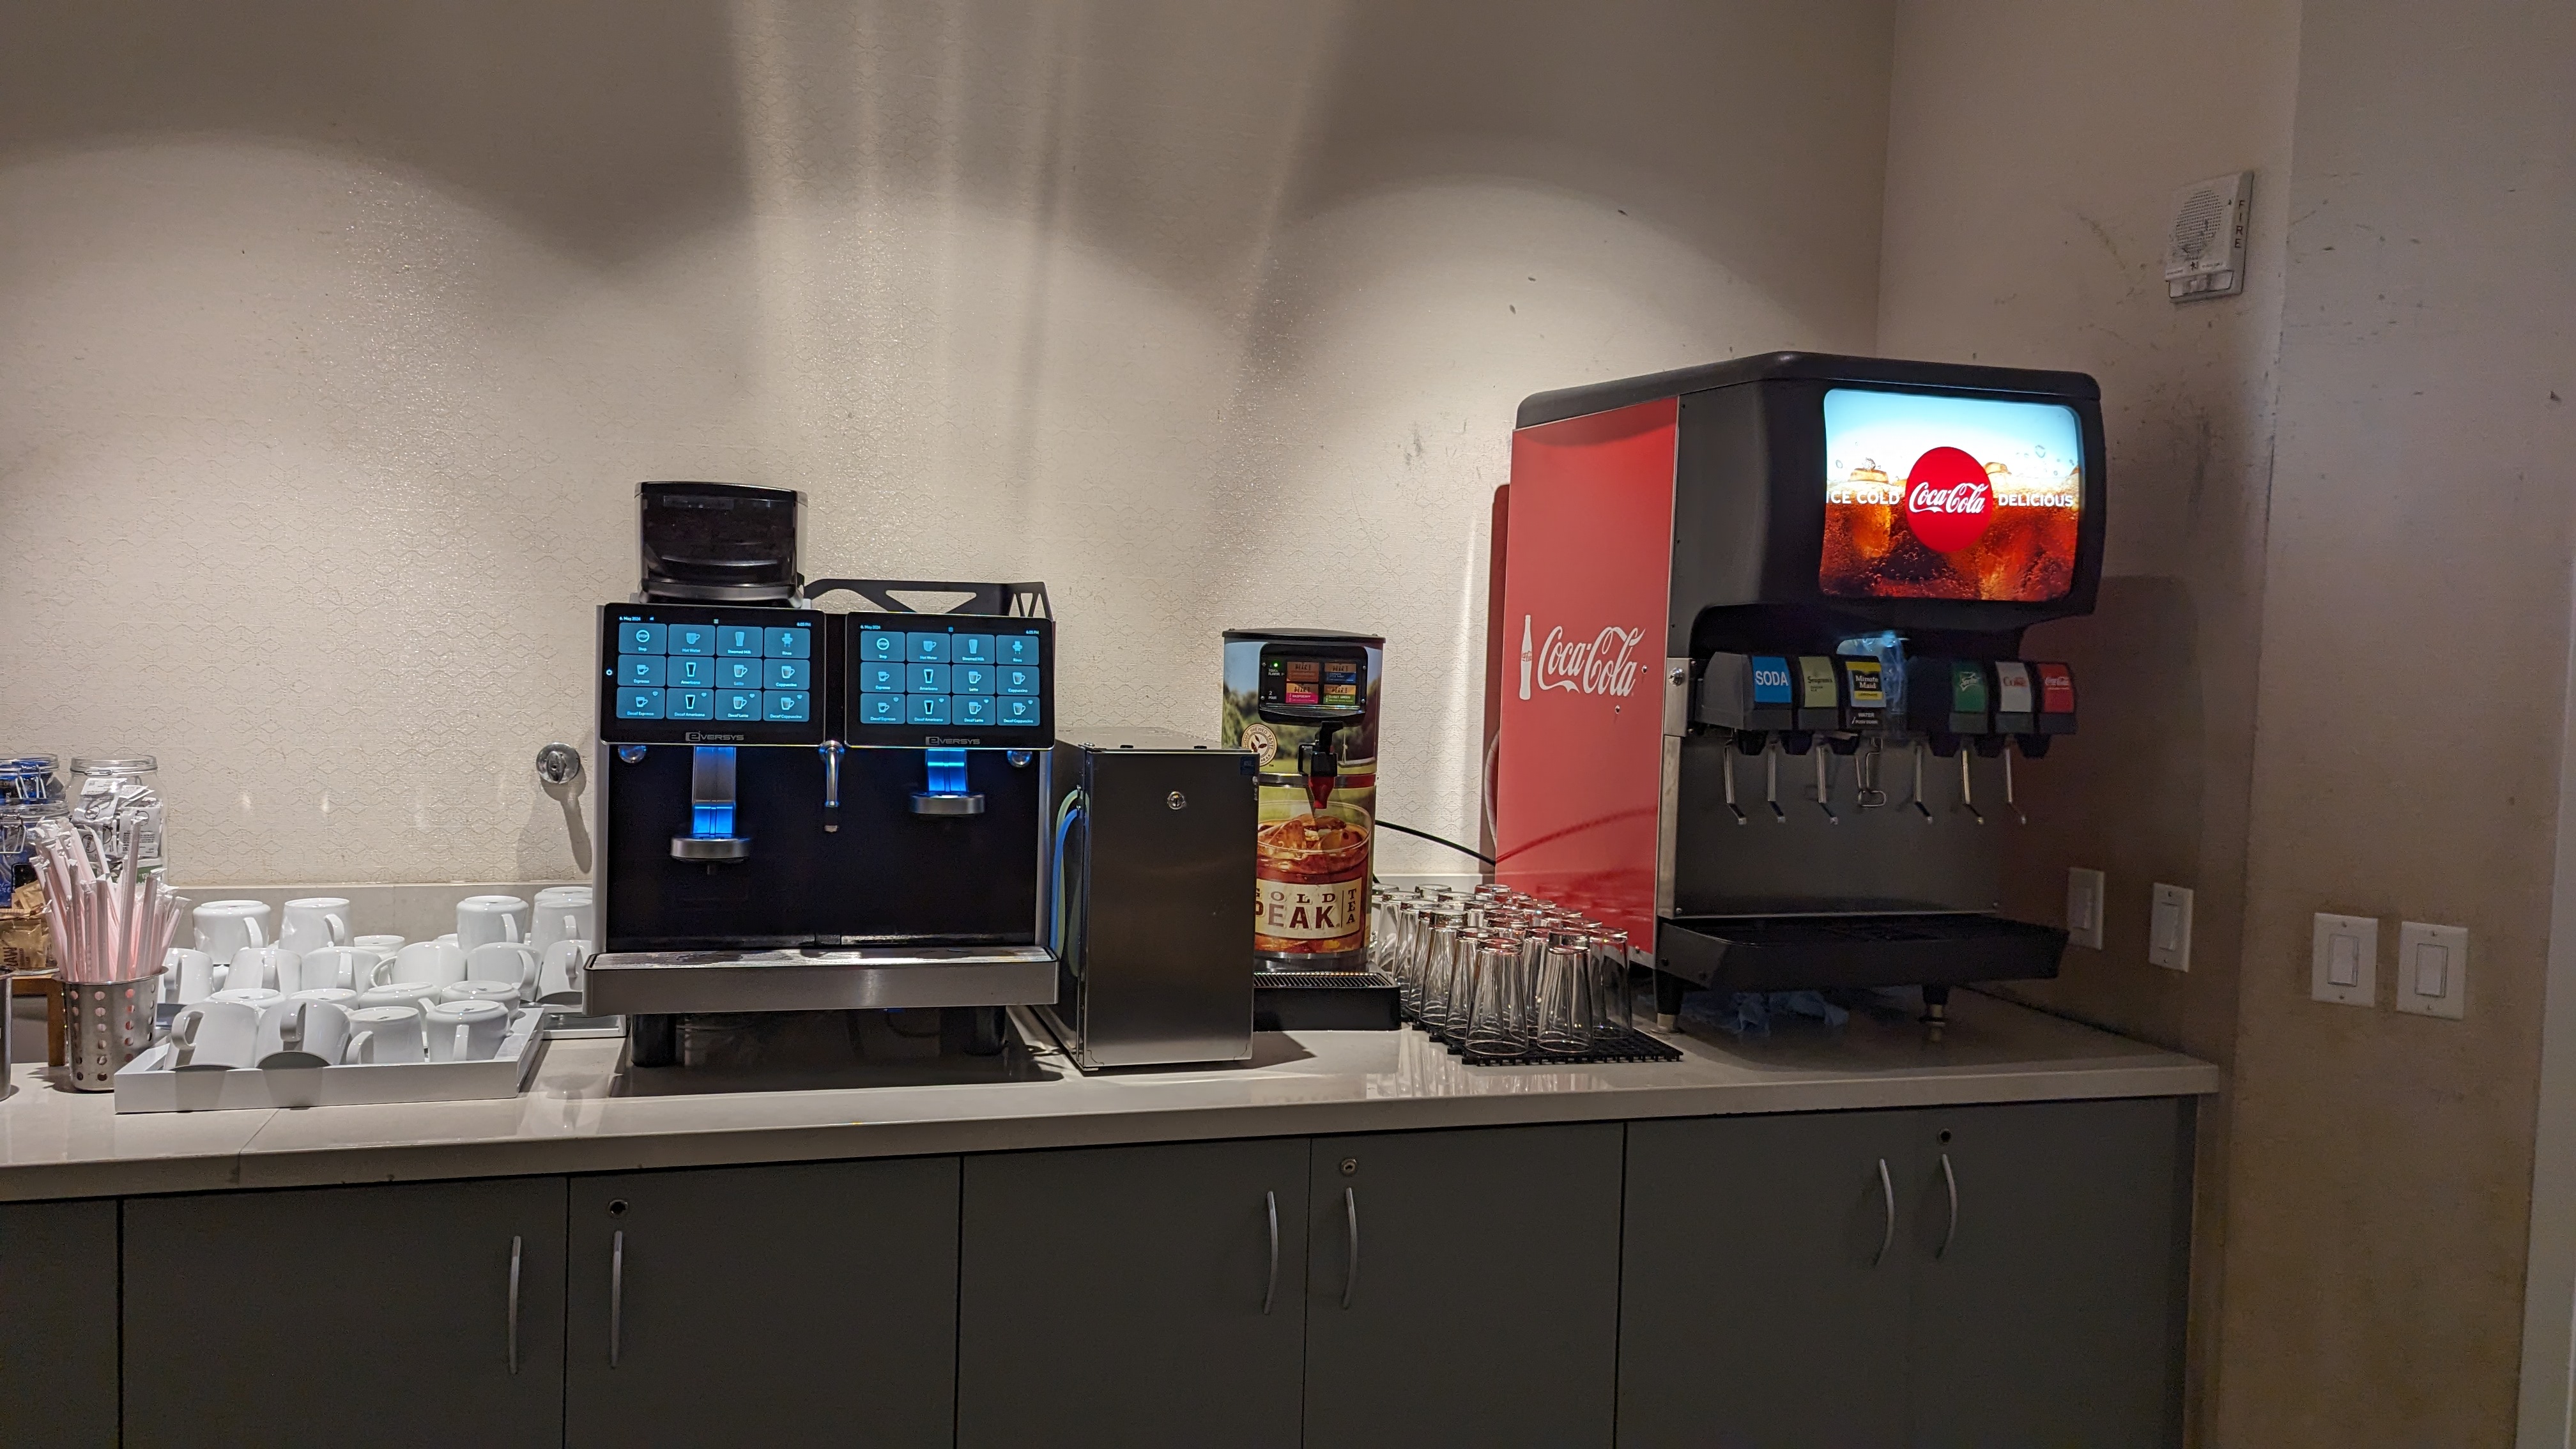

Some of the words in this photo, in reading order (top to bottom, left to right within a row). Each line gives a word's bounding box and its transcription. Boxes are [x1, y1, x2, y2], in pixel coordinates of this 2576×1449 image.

[2234, 200, 2245, 248] FIRE
[1826, 490, 1851, 504] ICE
[1857, 489, 1900, 505] COLD
[1908, 481, 1989, 514] Coca-Cola
[1998, 493, 2074, 507] DELICIOUS
[1537, 625, 1646, 697] Coca-Cola
[1755, 671, 1789, 686] SODA
[1346, 887, 1357, 924] TEA
